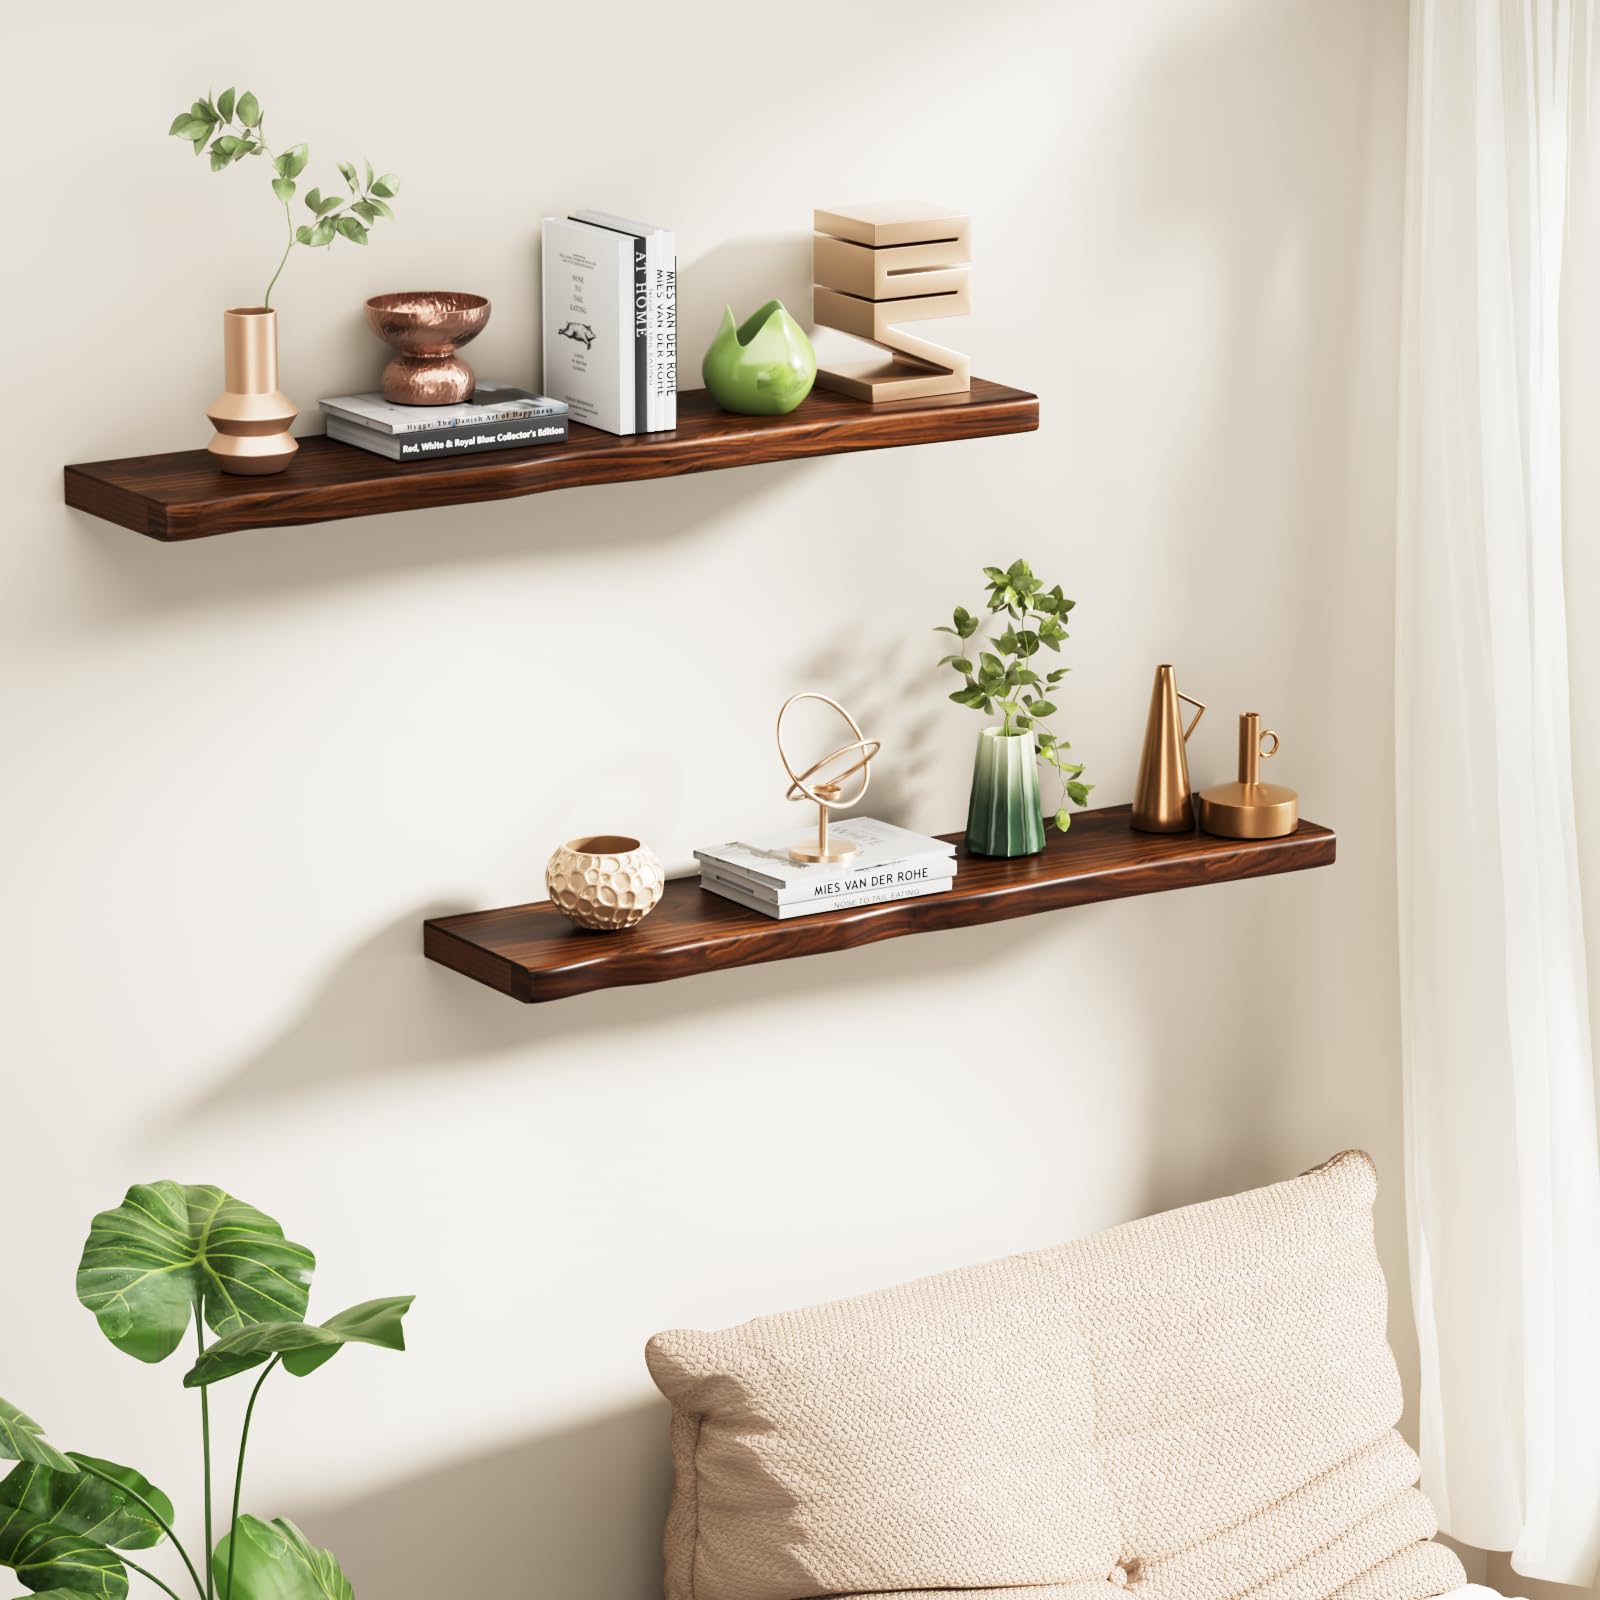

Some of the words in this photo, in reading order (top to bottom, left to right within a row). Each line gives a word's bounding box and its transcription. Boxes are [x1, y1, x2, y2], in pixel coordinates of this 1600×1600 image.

[636, 251, 647, 274] AT
[666, 271, 676, 300] MIES
[636, 283, 648, 337] HOME
[656, 303, 664, 328] VAN
[666, 303, 676, 328] VAN
[666, 333, 676, 358] DER
[666, 362, 676, 397] ROHE
[455, 415, 483, 425] Danish
[487, 413, 499, 421] Art
[512, 407, 553, 418] Happiness
[402, 443, 420, 454] Red,
[421, 440, 445, 451] White
[445, 439, 454, 448] &
[454, 436, 476, 448] Royal
[497, 429, 537, 442] Collector's
[537, 426, 565, 437] Edition
[814, 882, 841, 897] MIES
[844, 877, 867, 891] VAN
[871, 873, 893, 887] DER
[897, 867, 929, 882] ROHE
[834, 899, 855, 909] NOSE
[859, 896, 870, 905] TO
[890, 888, 920, 900] EATING
